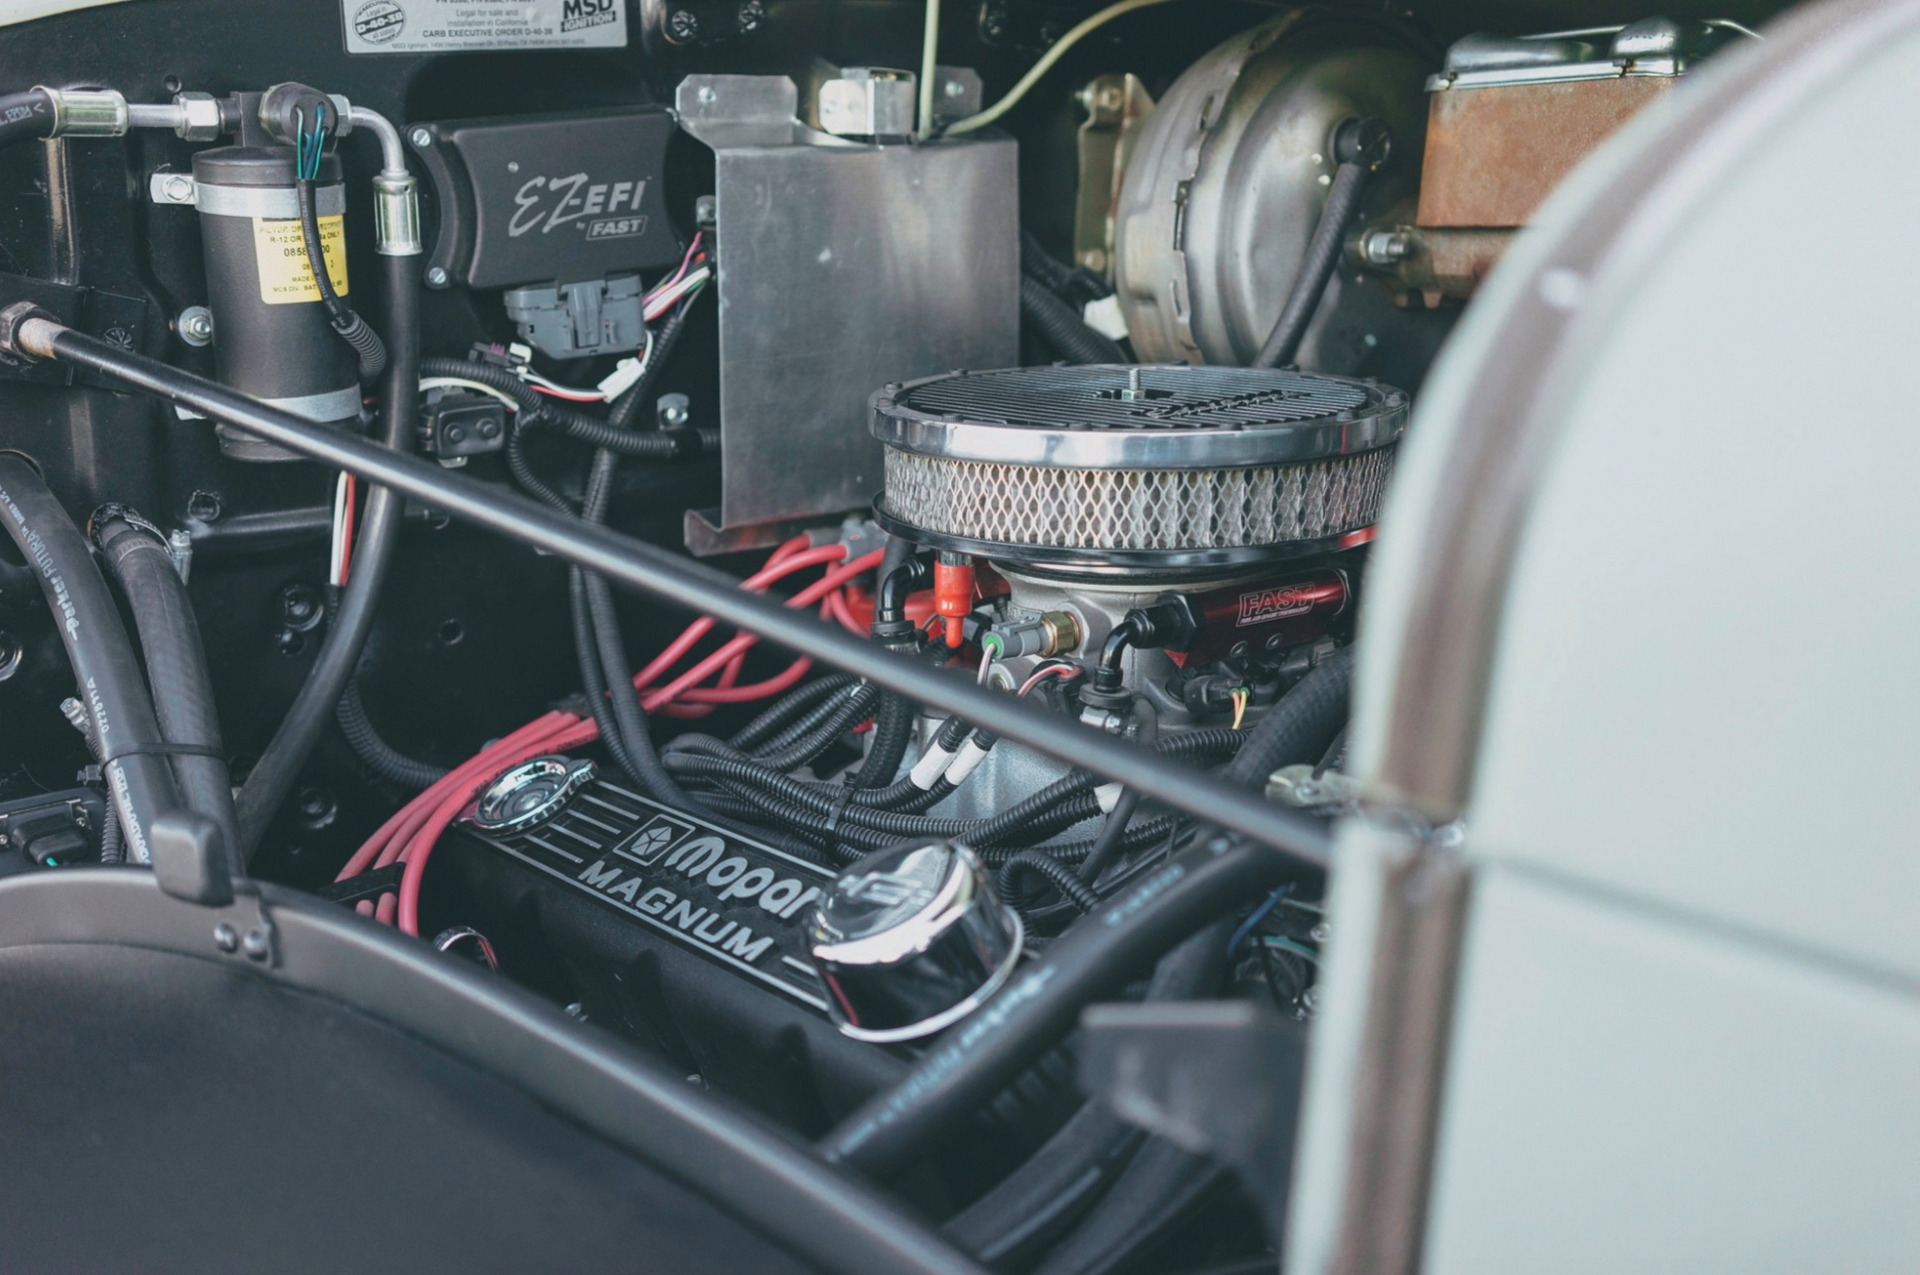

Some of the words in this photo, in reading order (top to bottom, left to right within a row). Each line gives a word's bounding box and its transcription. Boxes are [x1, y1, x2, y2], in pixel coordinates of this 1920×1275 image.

[456, 9, 475, 18] Legal
[477, 9, 487, 17] for
[505, 9, 519, 17] and
[564, 0, 613, 19] MSD
[357, 11, 403, 33] D-40-38
[423, 29, 446, 38] CARB
[448, 28, 493, 37] EXECUTIVE
[494, 27, 523, 37] ORDER
[564, 12, 613, 31] IGNITION
[592, 219, 643, 236] FAST
[26, 529, 57, 578] FUTURA
[50, 575, 80, 641] Parker
[1243, 584, 1313, 617] FAST
[664, 836, 821, 919] Mopar
[578, 860, 774, 961] MAGNUM
